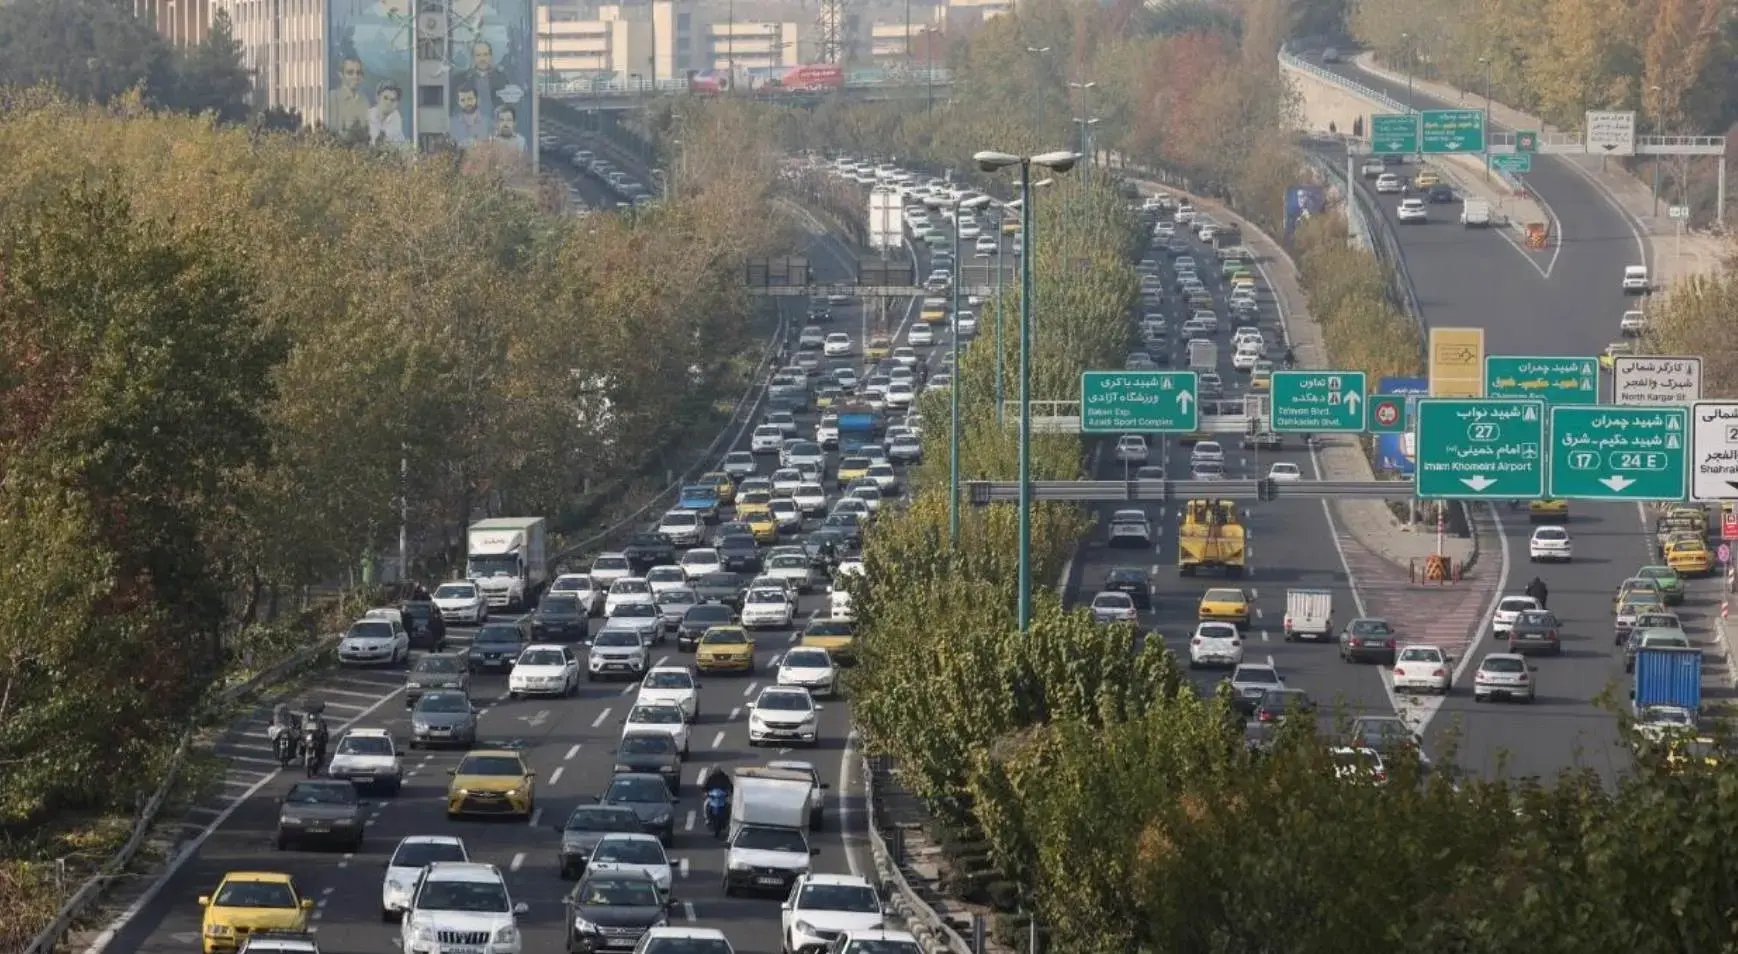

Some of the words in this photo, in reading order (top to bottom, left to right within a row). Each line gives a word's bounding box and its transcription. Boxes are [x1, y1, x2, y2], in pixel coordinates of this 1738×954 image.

[1621, 392, 1645, 401] North
[1490, 406, 1521, 419] شهید
[1632, 414, 1663, 428] شهید
[1475, 425, 1493, 438] 27
[1497, 462, 1532, 472] Airport
[1576, 453, 1593, 468] 17
[1621, 454, 1641, 468] 24
[1647, 454, 1657, 468] E
